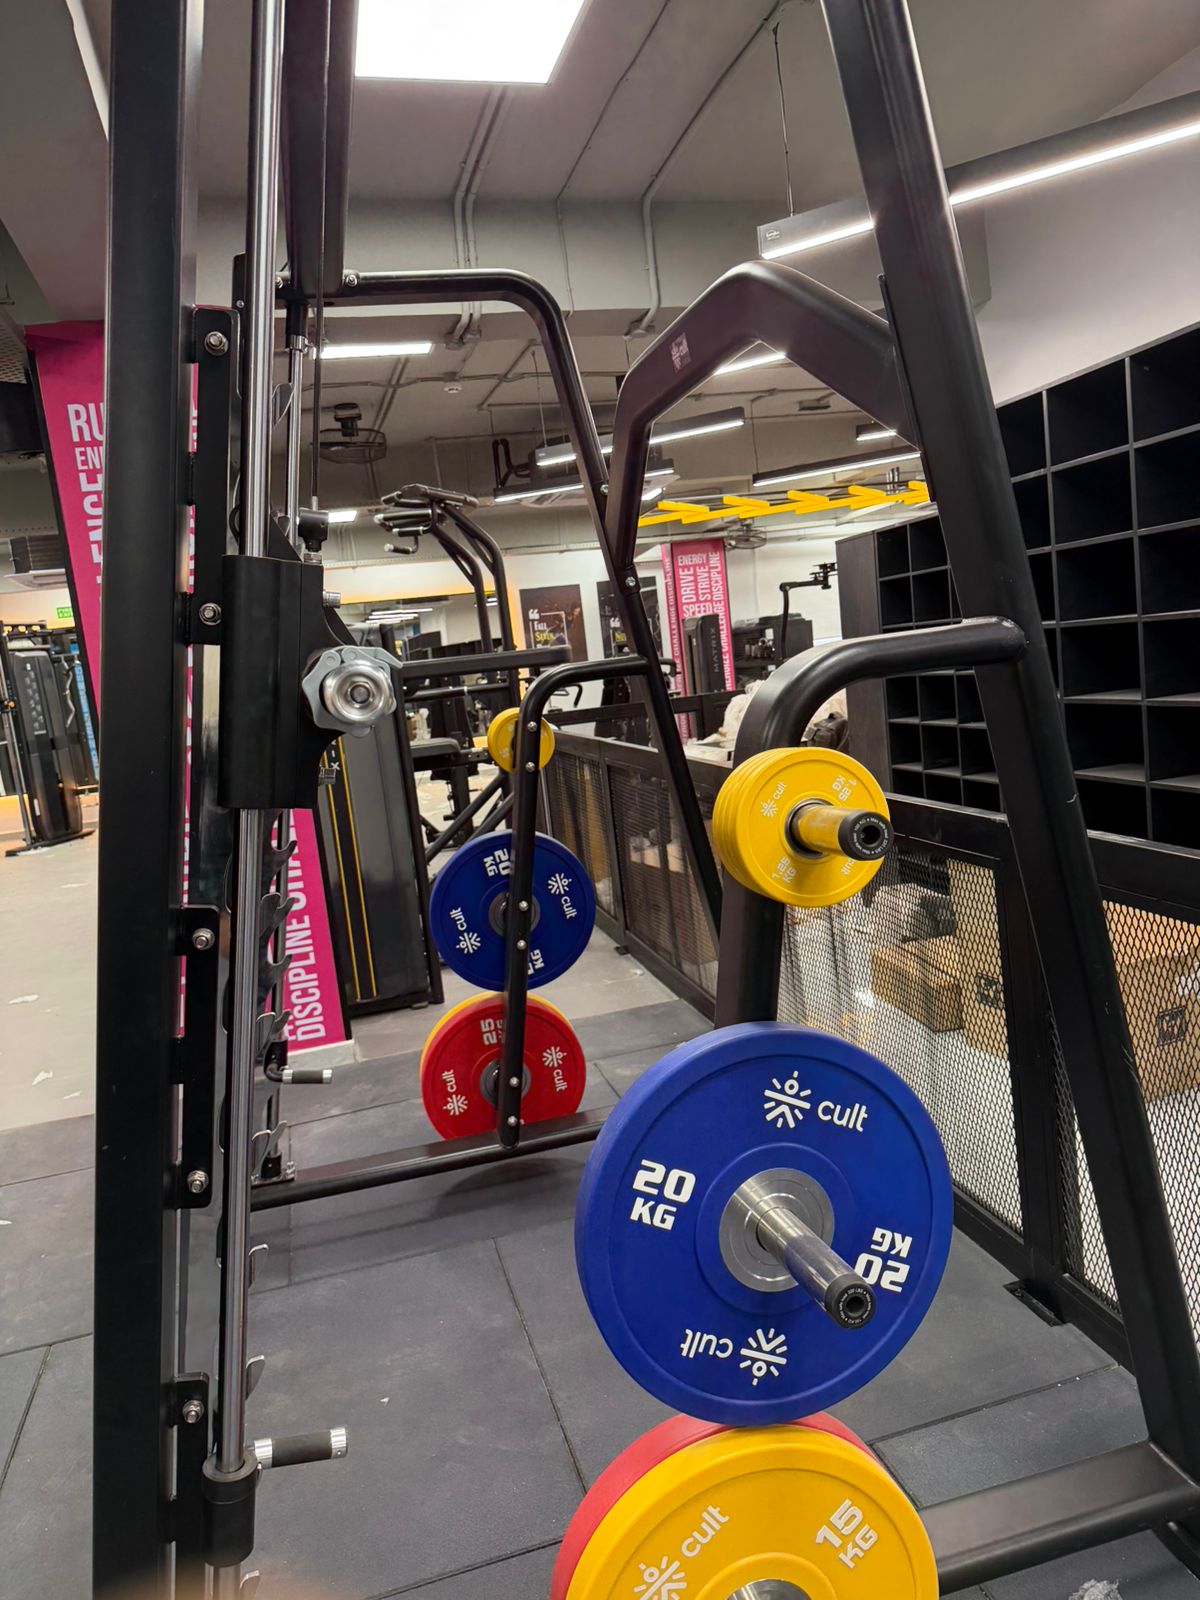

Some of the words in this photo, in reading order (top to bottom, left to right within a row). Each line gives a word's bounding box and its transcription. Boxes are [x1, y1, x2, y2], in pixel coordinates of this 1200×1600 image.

[678, 553, 707, 566] ENERGY
[679, 567, 697, 604] DRIVE
[696, 565, 711, 601] STRIVE
[709, 551, 725, 600] DISCIPLINE
[683, 602, 713, 617] SPEED
[710, 627, 720, 673] MATRIX
[772, 782, 788, 800] cult
[832, 775, 846, 791] KG
[483, 856, 499, 877] KG
[494, 848, 512, 876] 20
[782, 867, 797, 883] KG
[450, 907, 467, 931] cult
[561, 896, 577, 919] cult
[530, 949, 545, 970] KG
[286, 915, 326, 1041] DISCIPLINE
[480, 1018, 497, 1046] 25
[442, 1069, 457, 1092] cult
[553, 1069, 568, 1092] cult
[817, 1100, 868, 1132] cult
[632, 1159, 697, 1203] 20
[629, 1197, 677, 1230] KG
[870, 1226, 913, 1258] KG
[854, 1252, 910, 1293] 20
[680, 1328, 733, 1359] cult
[681, 1504, 731, 1558] cult
[815, 1499, 865, 1550] 15
[838, 1524, 879, 1569] KG
